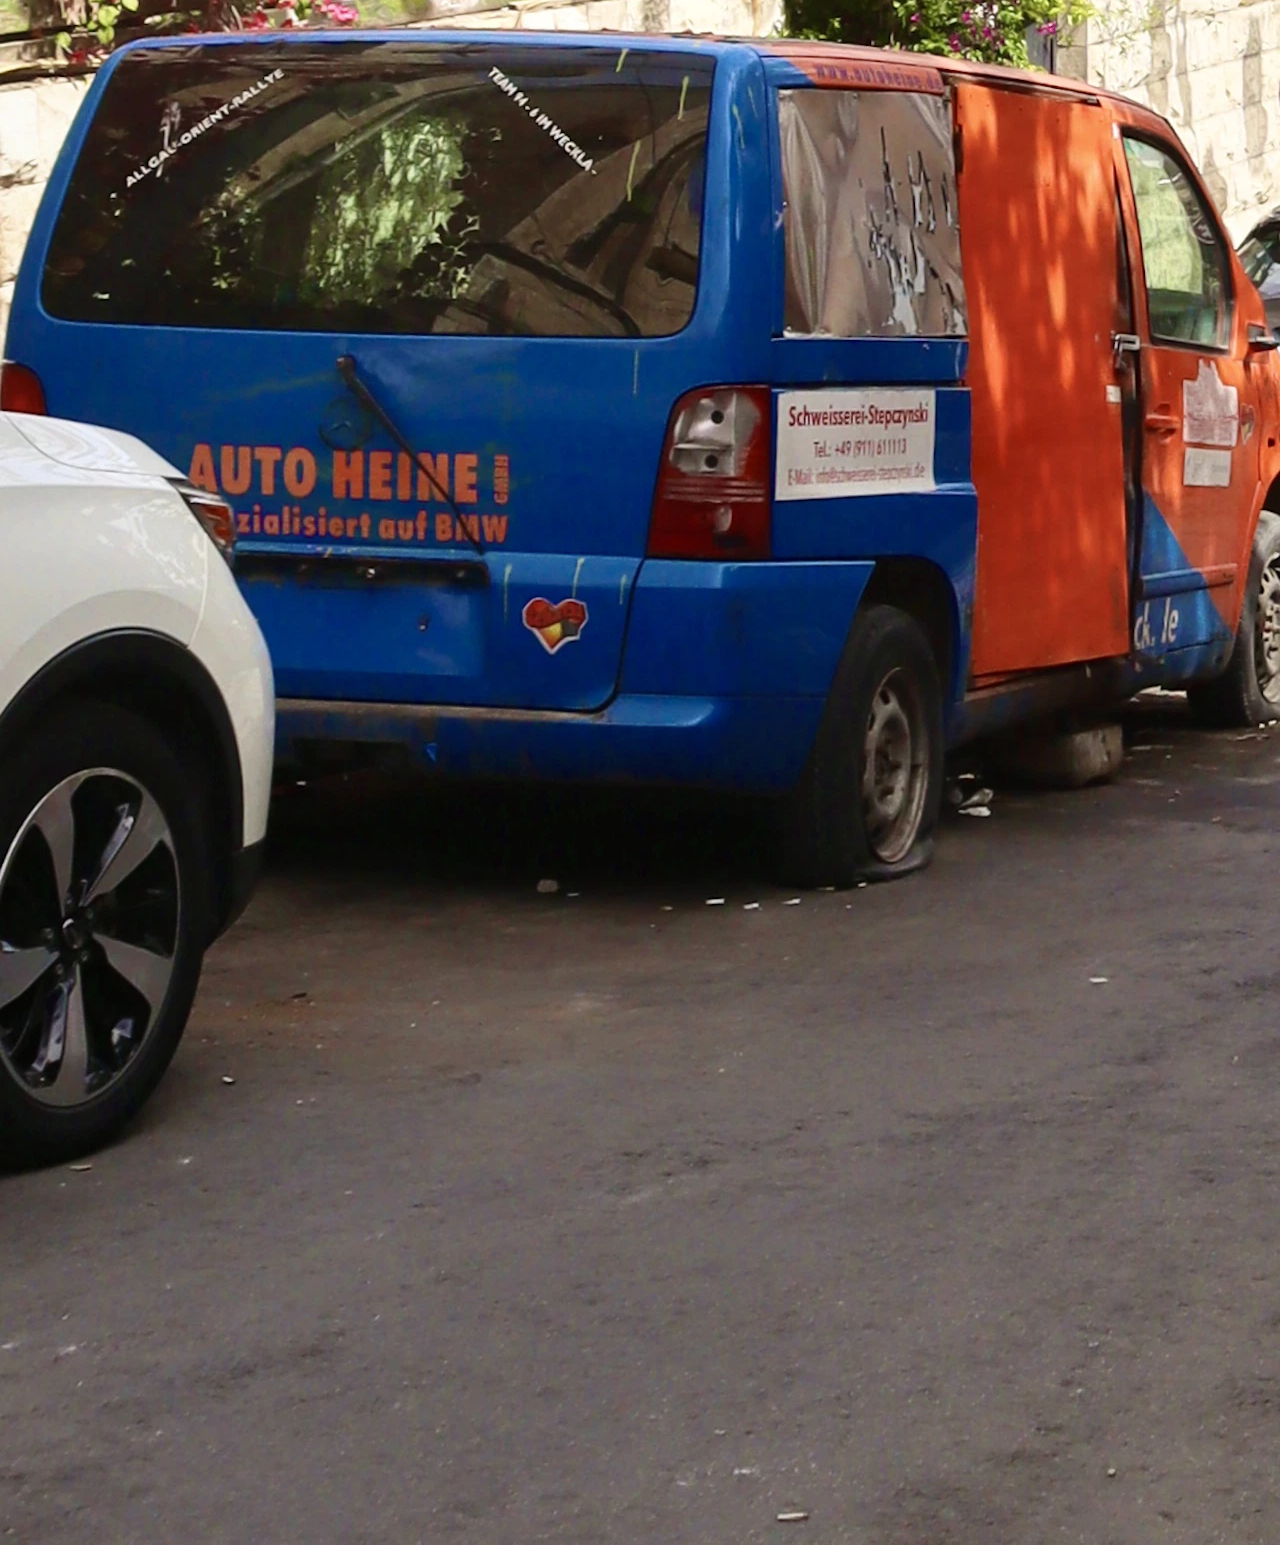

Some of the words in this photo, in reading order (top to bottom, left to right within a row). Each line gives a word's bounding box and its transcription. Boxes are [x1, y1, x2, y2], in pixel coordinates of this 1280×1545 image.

[488, 66, 518, 97] TEAM
[535, 113, 553, 130] IM
[189, 443, 317, 497] AUTO
[332, 450, 479, 504] HEINE
[378, 511, 428, 540] auf
[435, 514, 508, 544] BMW
